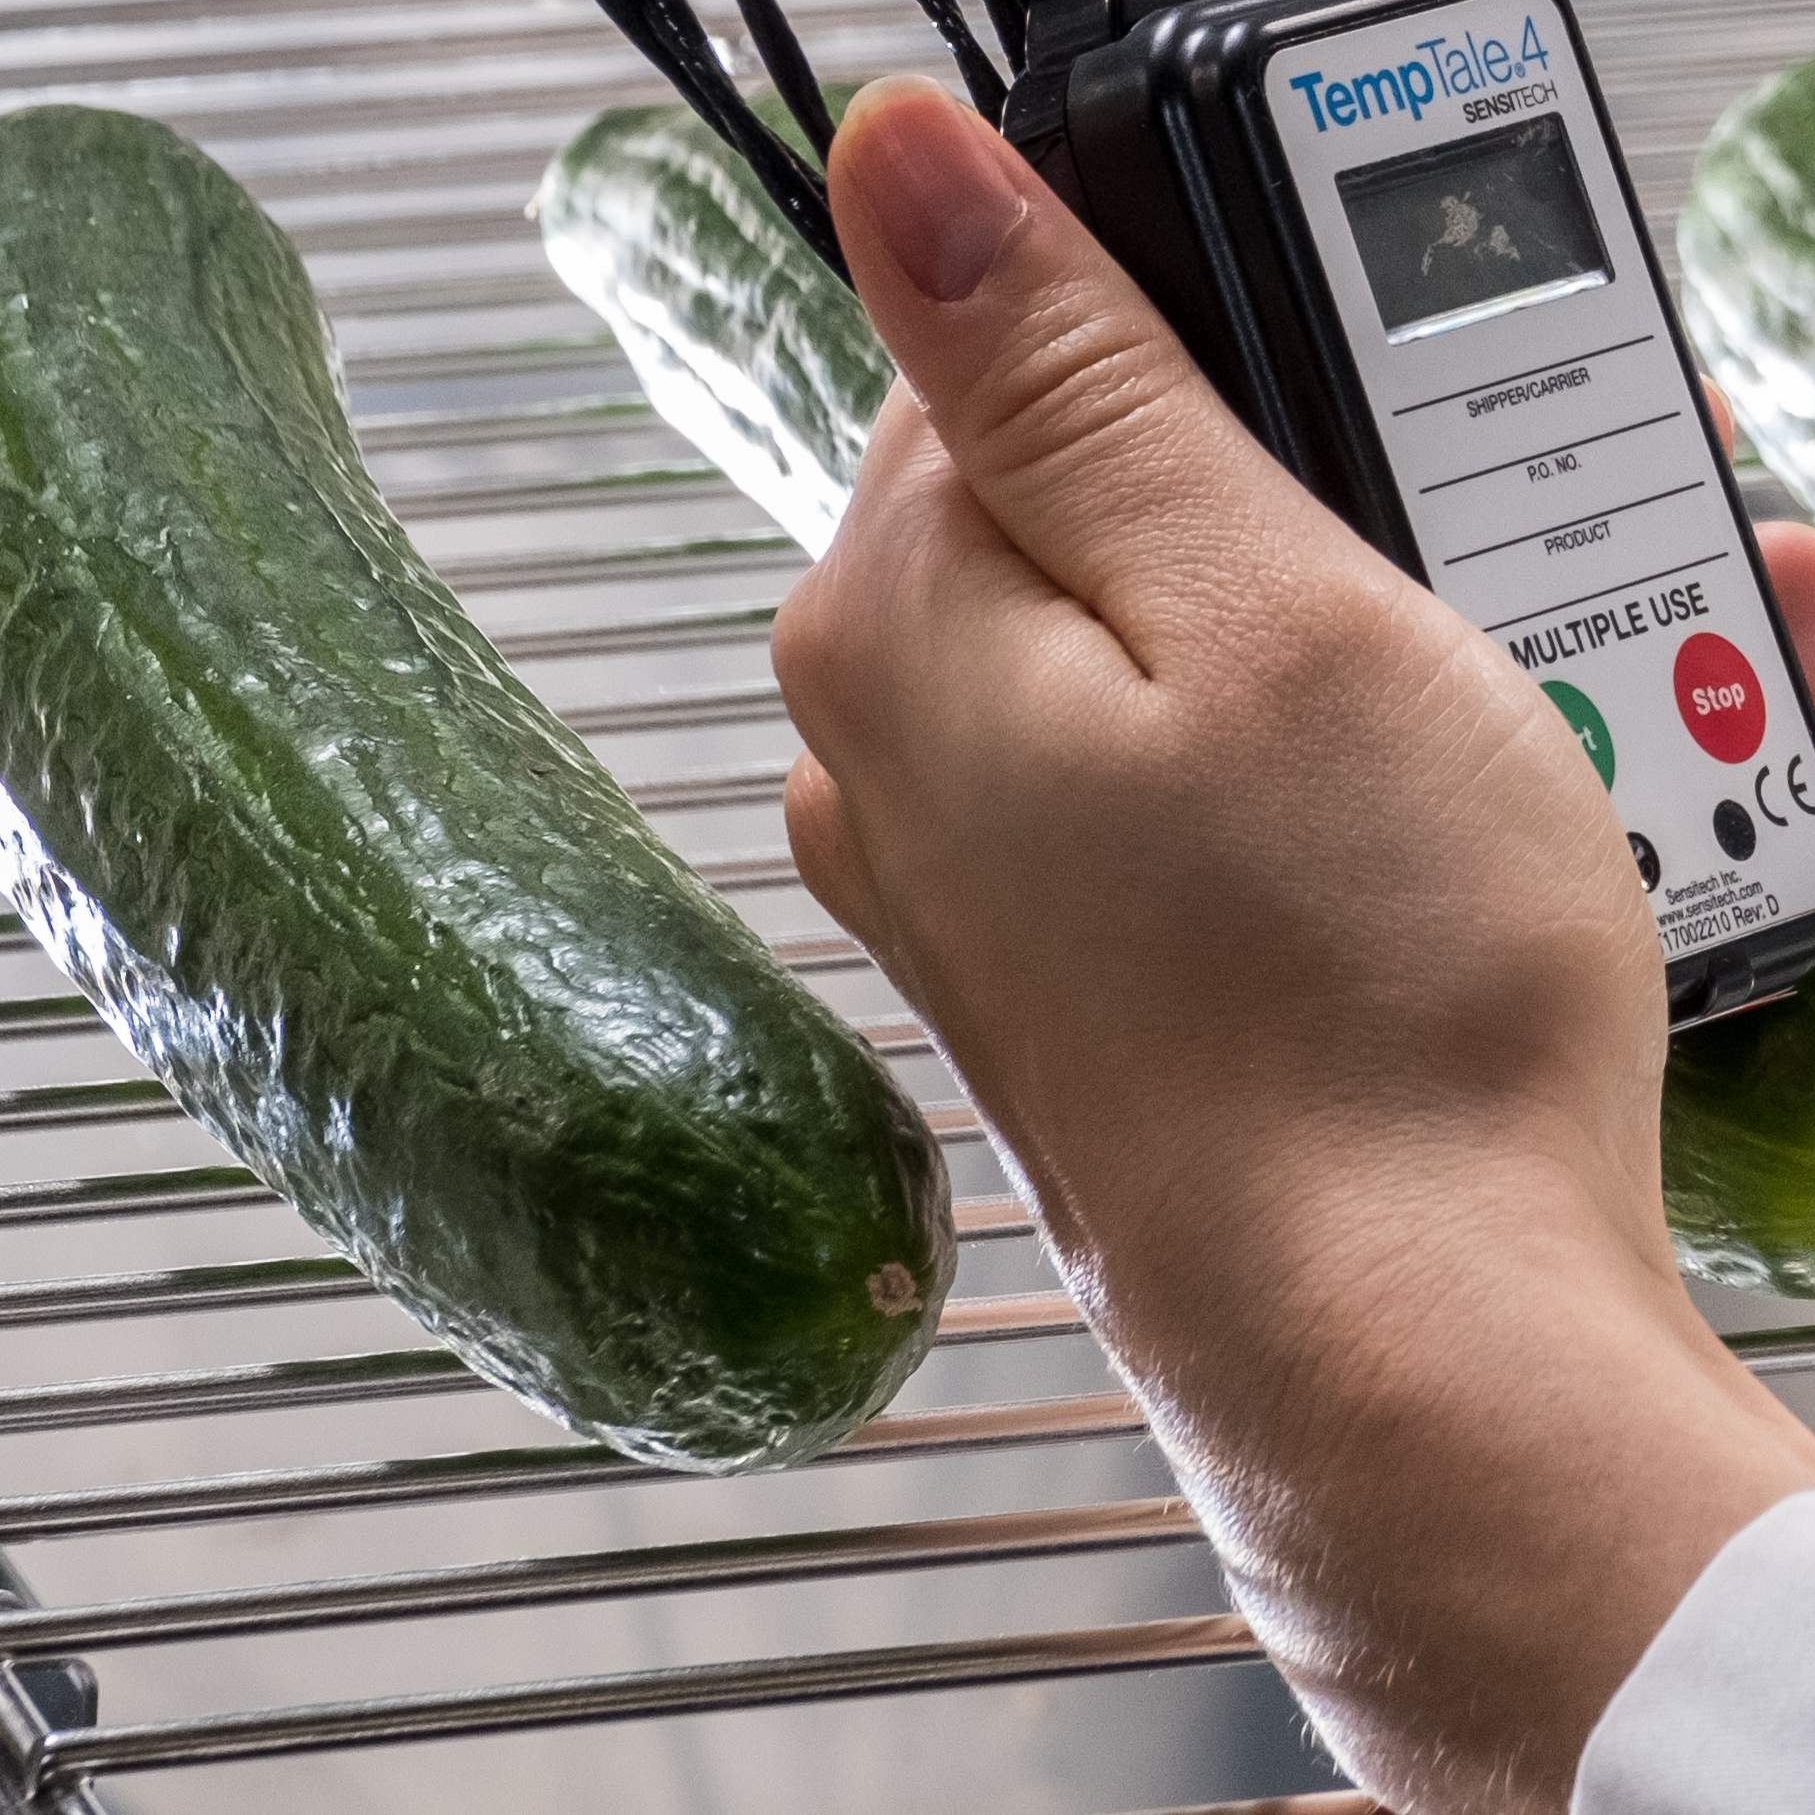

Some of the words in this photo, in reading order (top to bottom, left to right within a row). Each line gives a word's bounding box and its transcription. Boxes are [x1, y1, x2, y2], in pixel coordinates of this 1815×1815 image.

[1462, 79, 1558, 124] SENSITECH
[1466, 367, 1592, 418] SHIPPER/CARRIER
[1526, 461, 1555, 483] P.O.
[1554, 453, 1583, 475] NO.
[1544, 520, 1612, 556] PRODUCT
[1508, 601, 1649, 670] MULTIPLE
[1648, 582, 1710, 627] USE
[1692, 682, 1746, 716] Stop
[1656, 881, 1764, 928] www.sensitech.com
[1665, 875, 1720, 905] Sensitech
[1718, 870, 1743, 887] Inc.
[1658, 911, 1732, 953] 17002210
[1764, 894, 1780, 916] D
